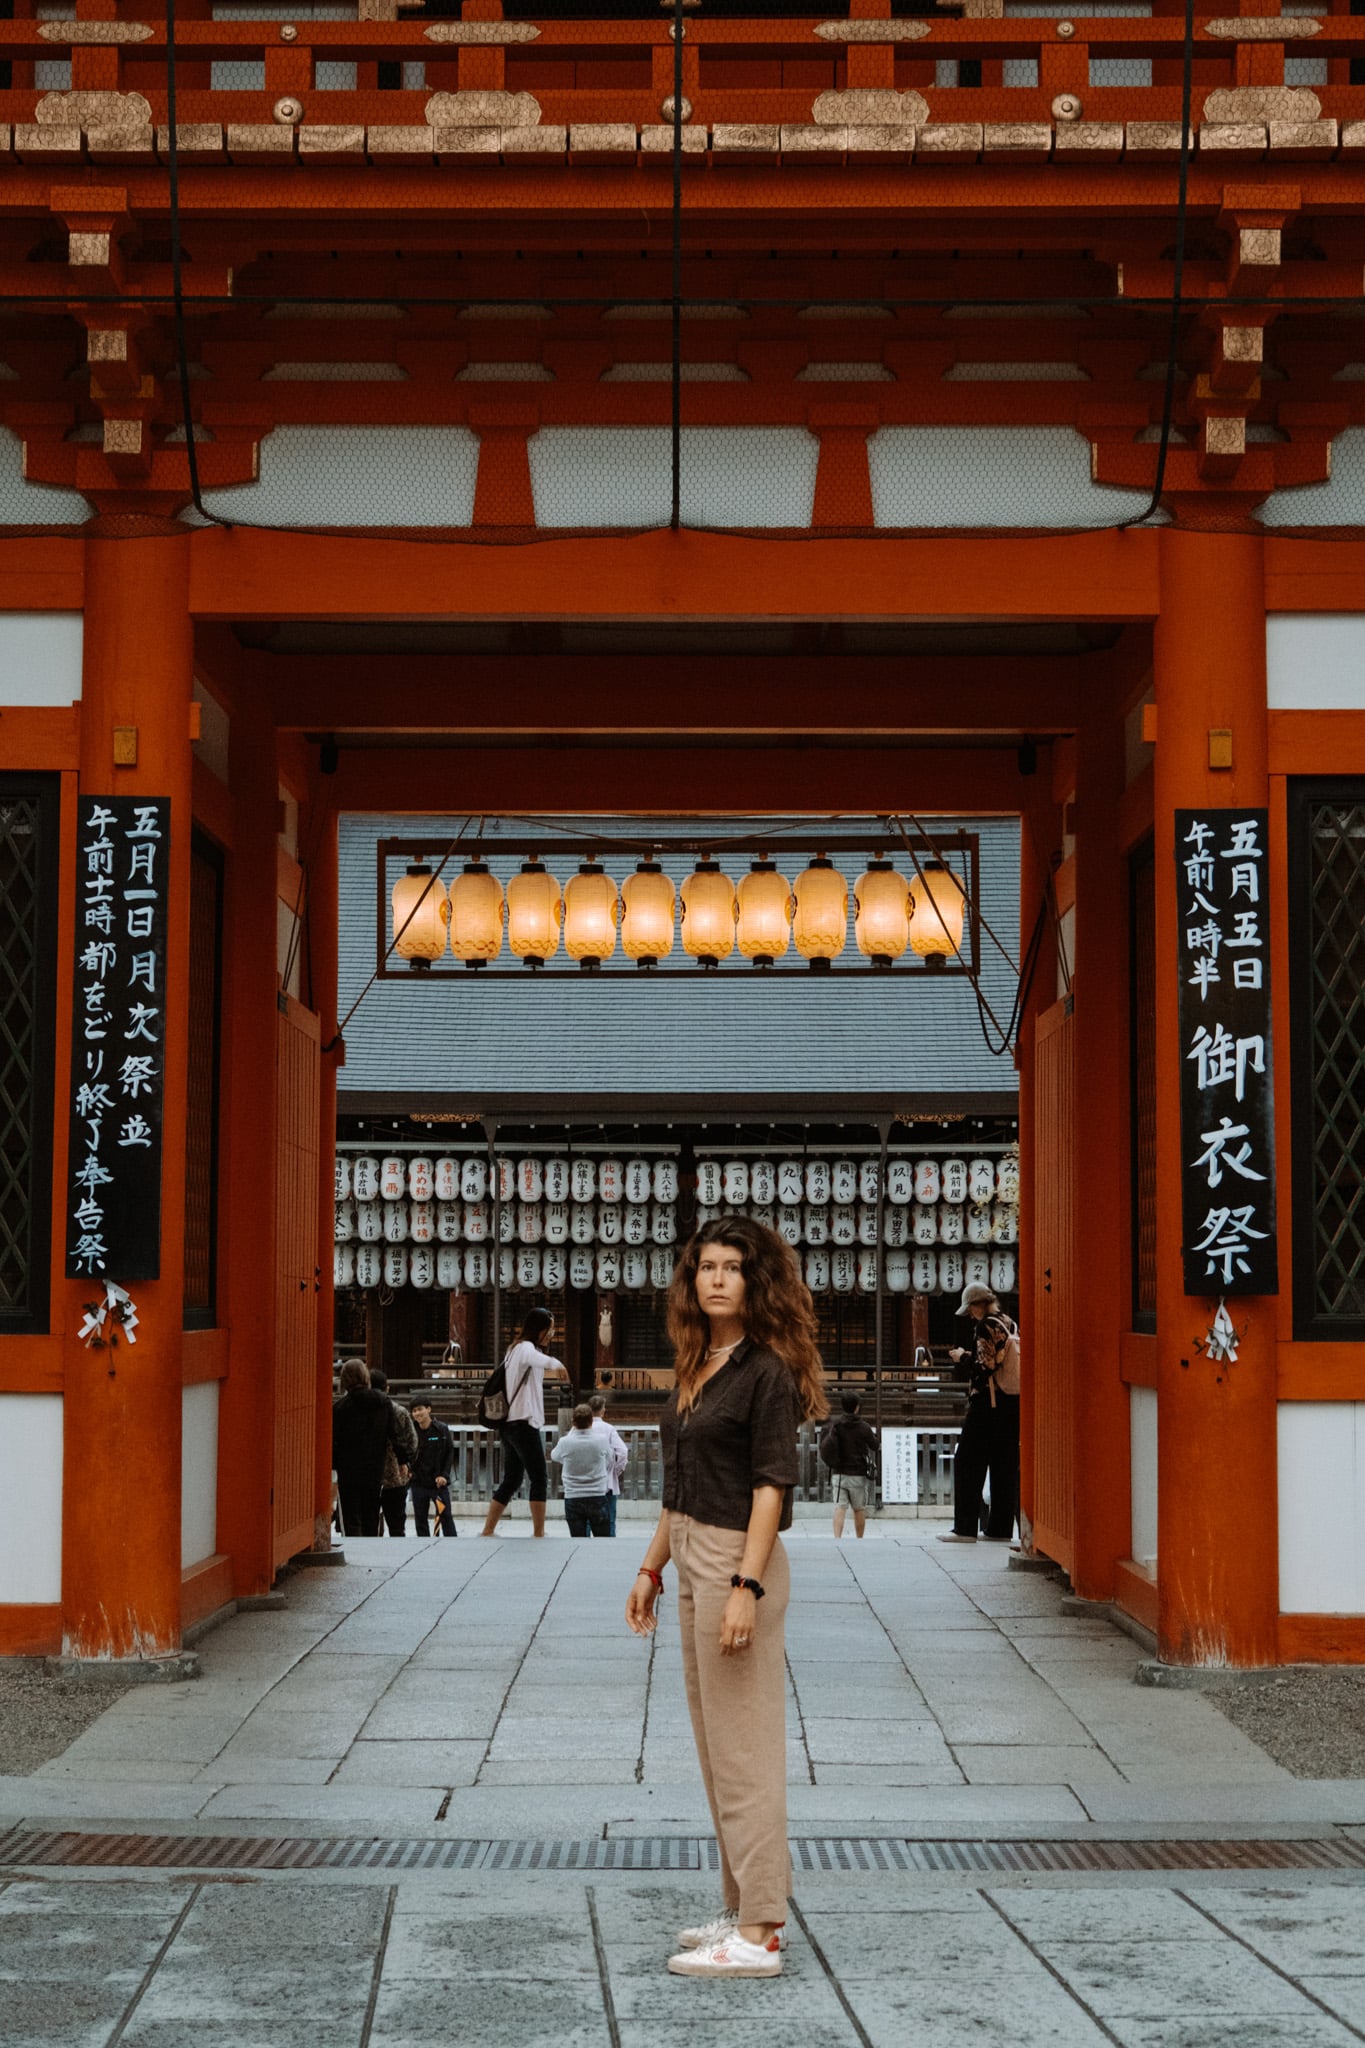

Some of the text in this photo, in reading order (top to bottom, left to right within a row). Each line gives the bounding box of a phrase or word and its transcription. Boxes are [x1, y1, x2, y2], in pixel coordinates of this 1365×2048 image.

[1183, 819, 1224, 1003] 午前八時半
[1220, 818, 1264, 990] 五月五日
[950, 1164, 961, 1198] 備前屋
[1186, 1022, 1273, 1286] 御衣祭
[418, 1250, 428, 1283] キメラ
[552, 1207, 562, 1234] 川口
